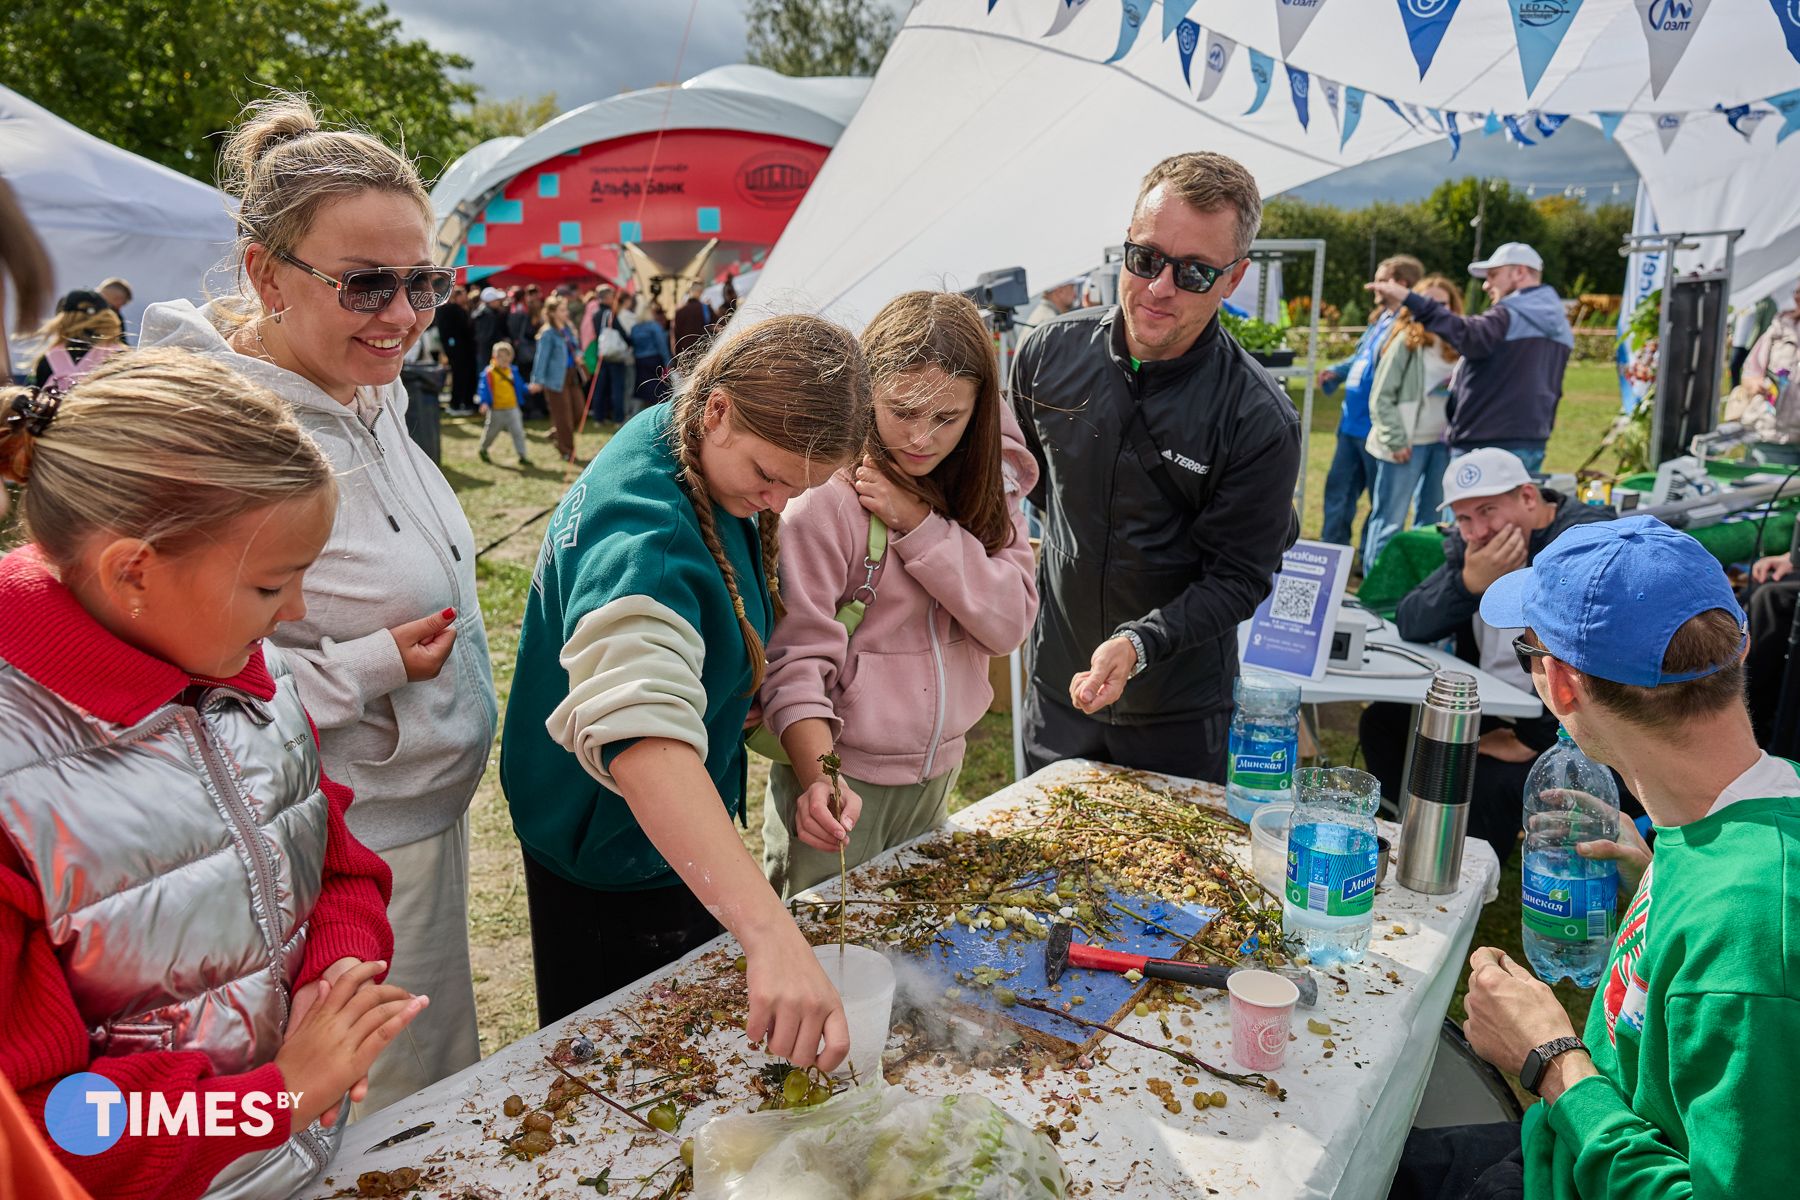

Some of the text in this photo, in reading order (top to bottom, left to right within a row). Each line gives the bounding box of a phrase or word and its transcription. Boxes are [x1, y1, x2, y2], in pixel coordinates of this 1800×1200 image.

[1663, 21, 1691, 31] ОЭЛТ
[591, 179, 641, 198] Альфа
[1238, 759, 1281, 770] Минская
[1555, 891, 1562, 899] 4
